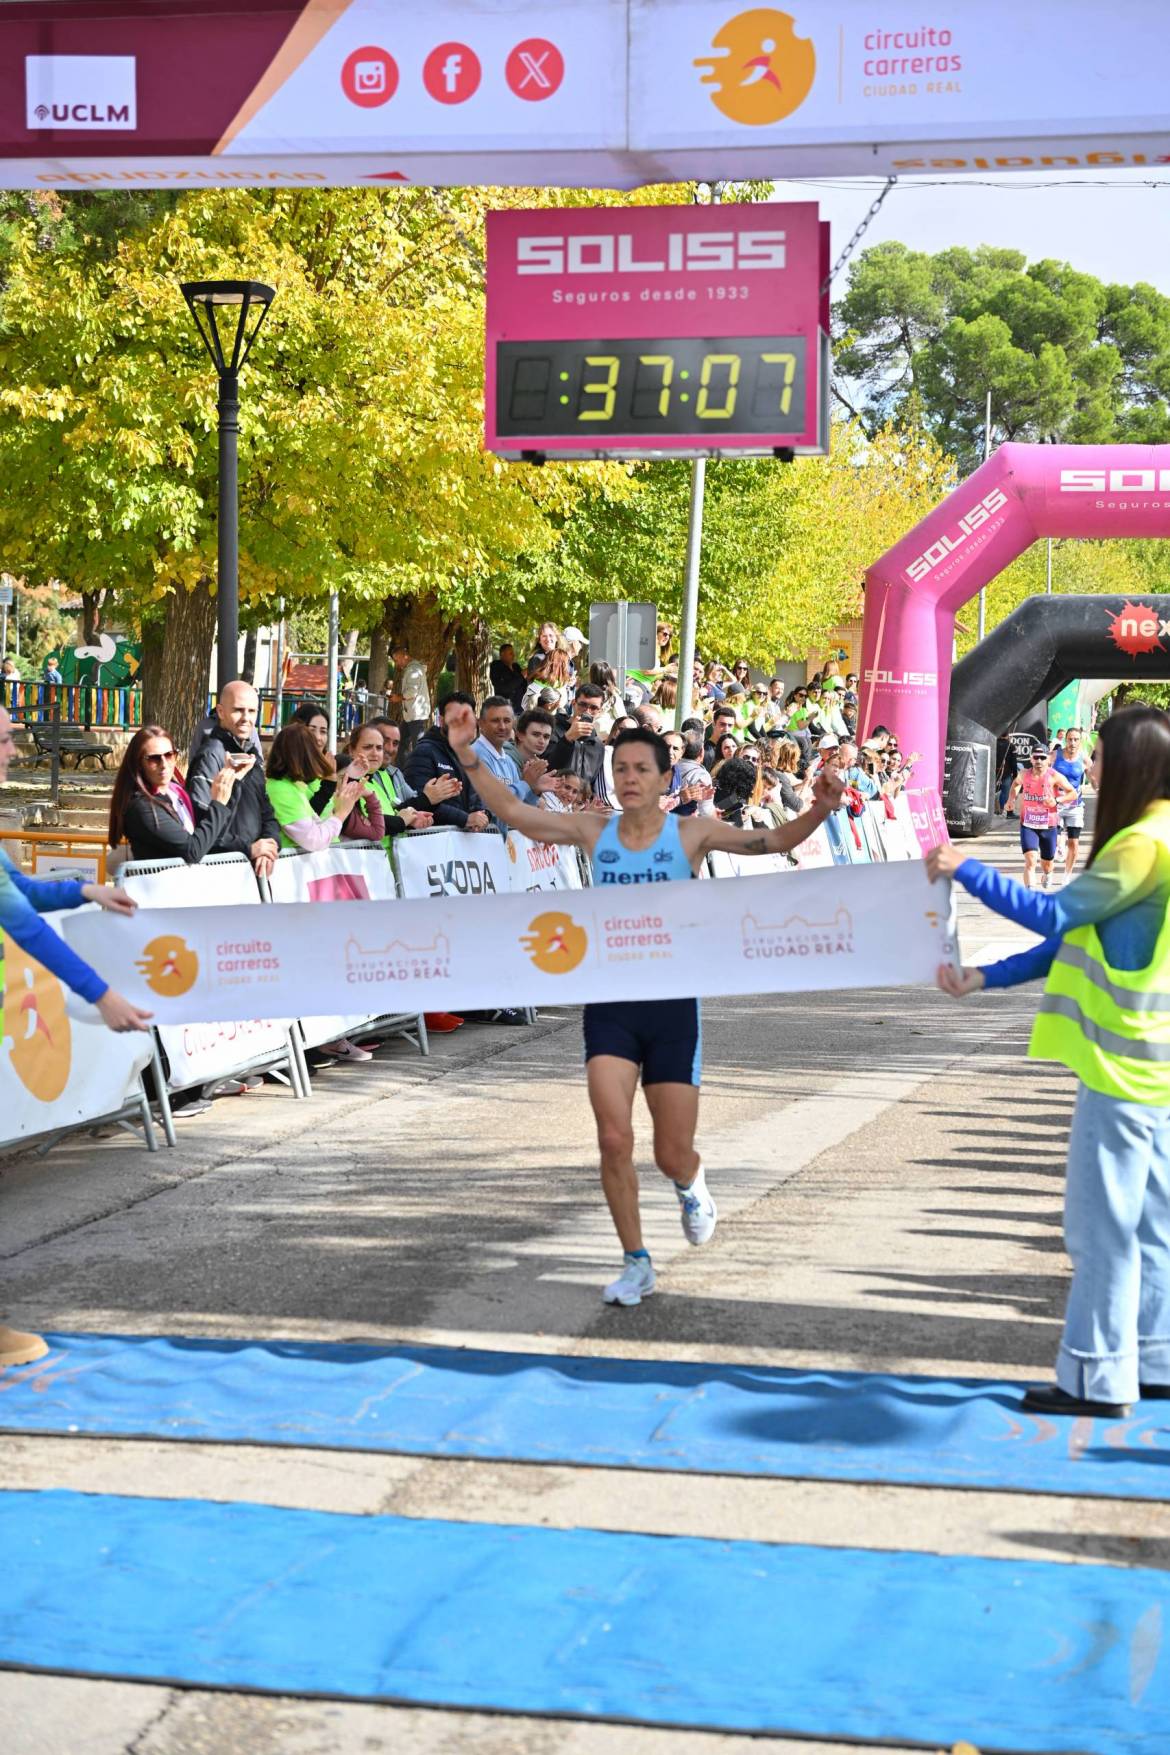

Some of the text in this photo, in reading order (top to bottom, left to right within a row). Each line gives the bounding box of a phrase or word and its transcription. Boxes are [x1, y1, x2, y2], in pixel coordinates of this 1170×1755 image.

[864, 26, 952, 51] circuito
[864, 55, 962, 76] carreras
[864, 80, 962, 97] CIUDAD REAL
[51, 105, 129, 123] UCLM
[517, 230, 786, 275] SOLISS
[552, 286, 750, 306] Seguros desde 1933
[905, 487, 1008, 582] SOLISS
[864, 669, 937, 686] SOLISS
[604, 915, 663, 931] circuito
[216, 939, 272, 956] circuito
[606, 932, 672, 948] carreras
[743, 942, 856, 959] CIUDAD REAL
[217, 956, 279, 971] carreras
[346, 967, 451, 983] CIUDAD REAL
